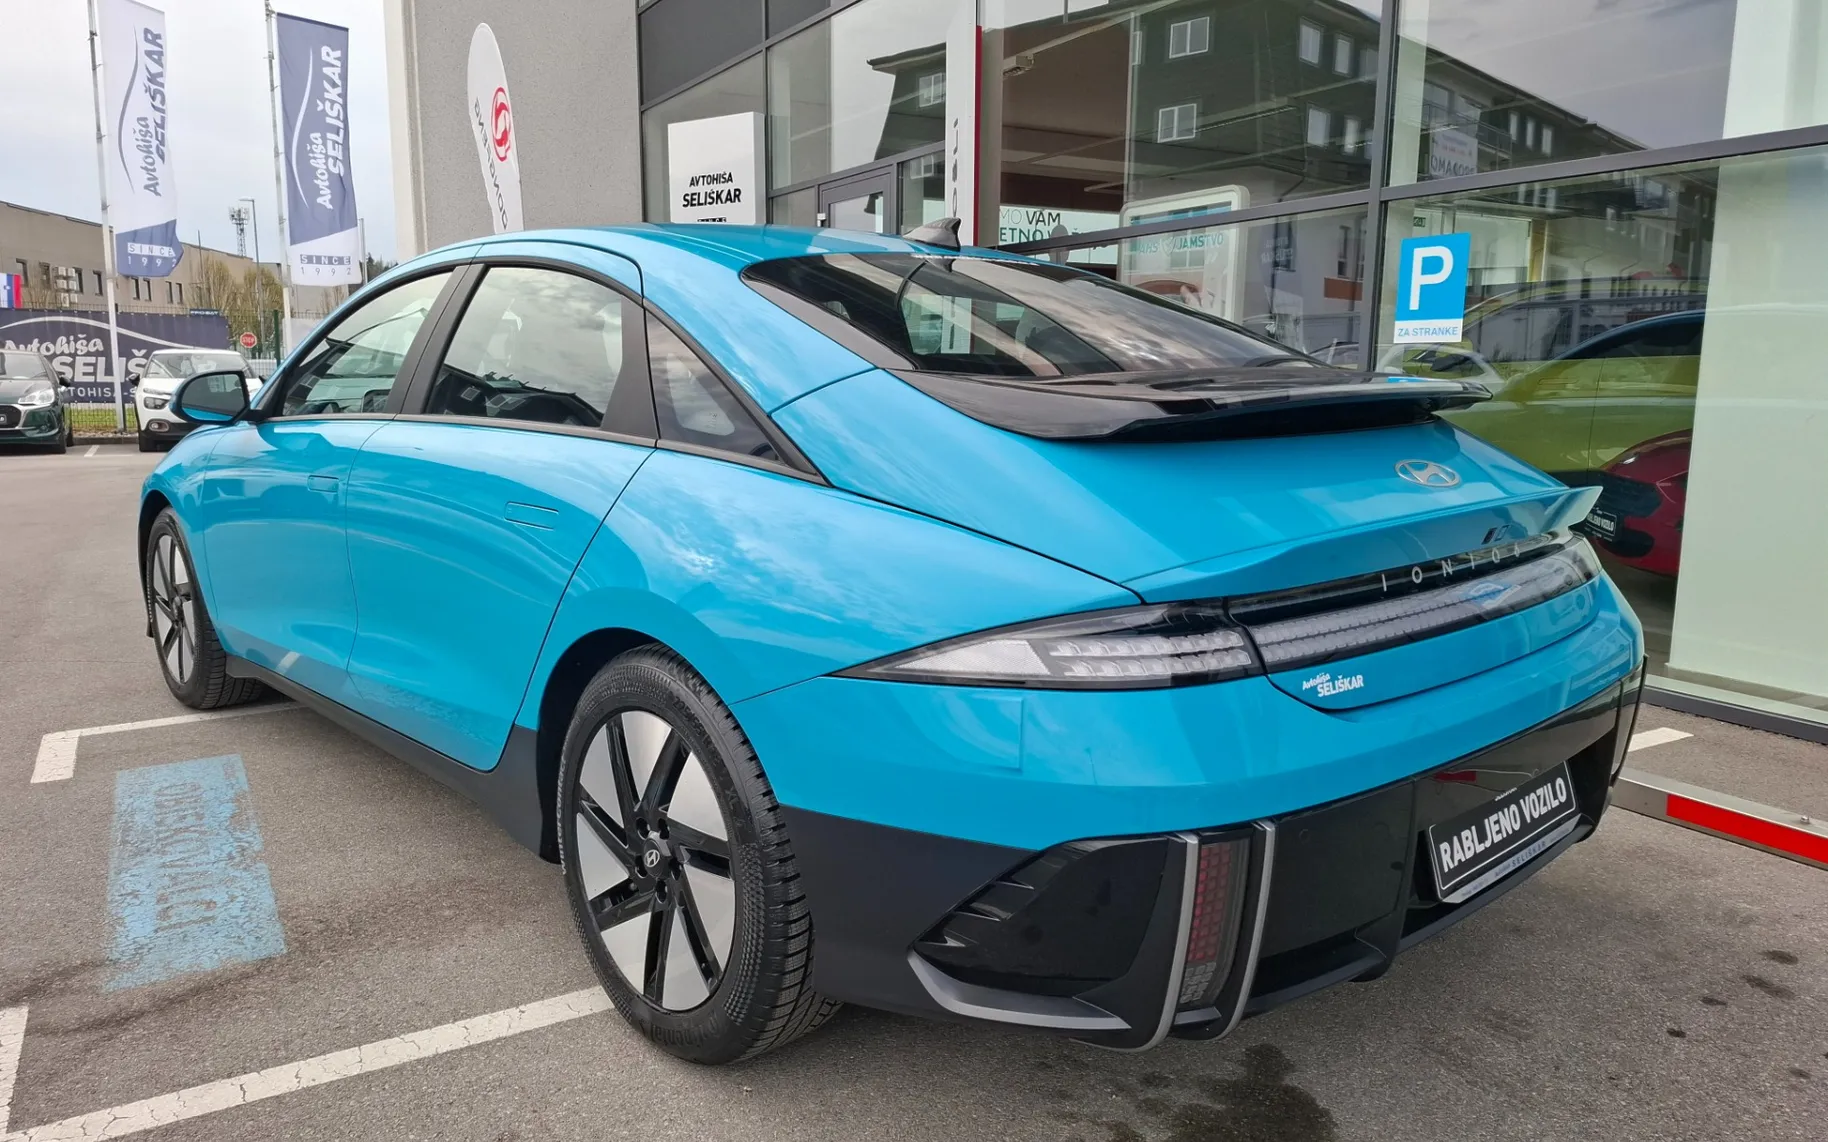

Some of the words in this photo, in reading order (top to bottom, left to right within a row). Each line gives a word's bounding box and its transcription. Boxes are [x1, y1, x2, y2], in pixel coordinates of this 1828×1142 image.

[316, 45, 345, 177] SELIŠKAR
[132, 116, 162, 198] Avtohiša
[306, 132, 334, 210] Avtohiša
[688, 171, 734, 188] AVTOHIŠA
[682, 188, 742, 208] SELIŠKAR
[1026, 210, 1061, 227] VAM
[128, 243, 174, 257] SINCE
[128, 255, 177, 268] 1992
[301, 254, 351, 265] SINCE
[301, 266, 352, 276] 1992
[1409, 245, 1454, 311] P
[1398, 328, 1410, 337] ZA
[1412, 326, 1458, 337] STRANKE
[1317, 675, 1364, 697] SELIŠKAR
[1439, 804, 1521, 873] RABLJENO
[1519, 777, 1567, 824] VOZILO
